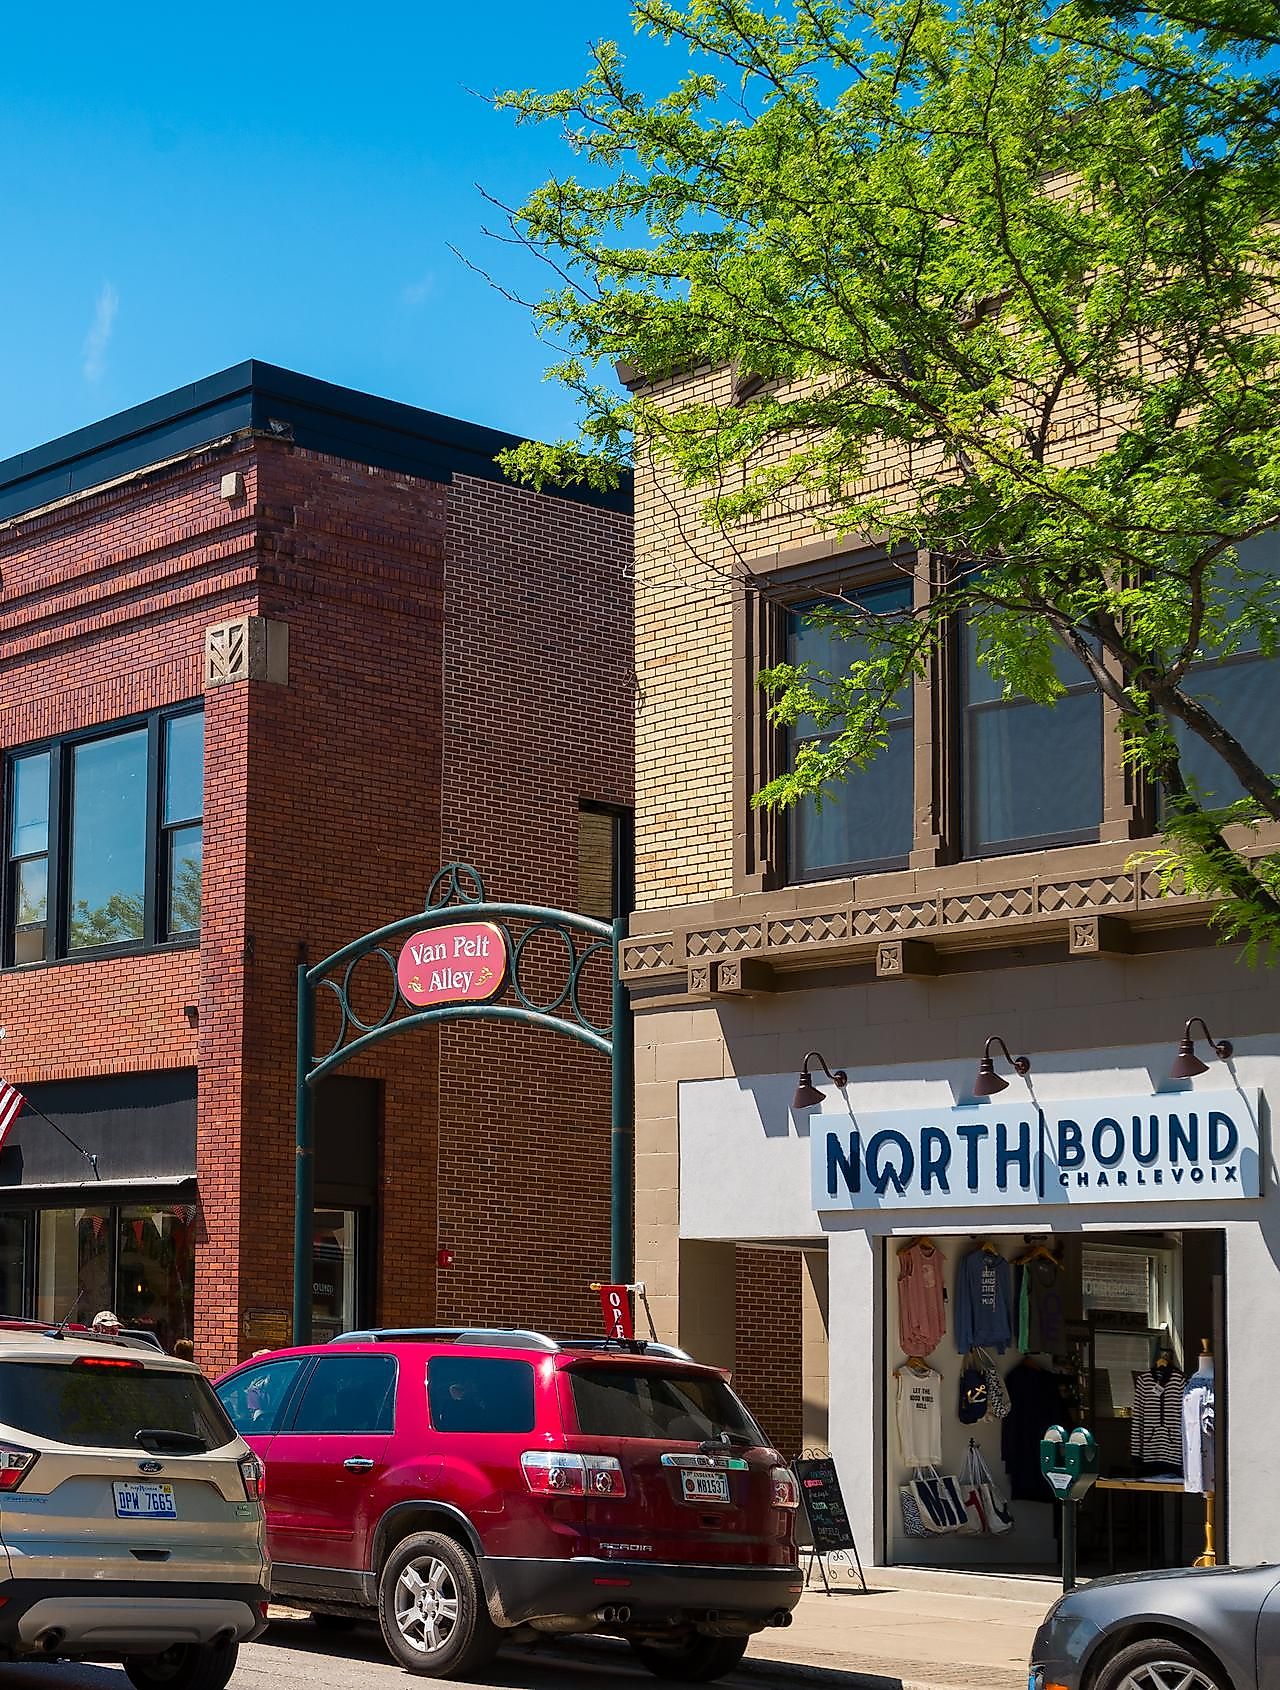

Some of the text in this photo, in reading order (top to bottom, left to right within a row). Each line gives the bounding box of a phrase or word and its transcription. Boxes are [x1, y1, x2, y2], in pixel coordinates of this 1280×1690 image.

[410, 934, 490, 966] Van Pelt
[428, 967, 475, 994] Alley
[826, 1111, 1238, 1197] NORTH BOUND
[1059, 1166, 1237, 1187] CHARLEVOIX
[118, 1492, 174, 1512] DPW 7665
